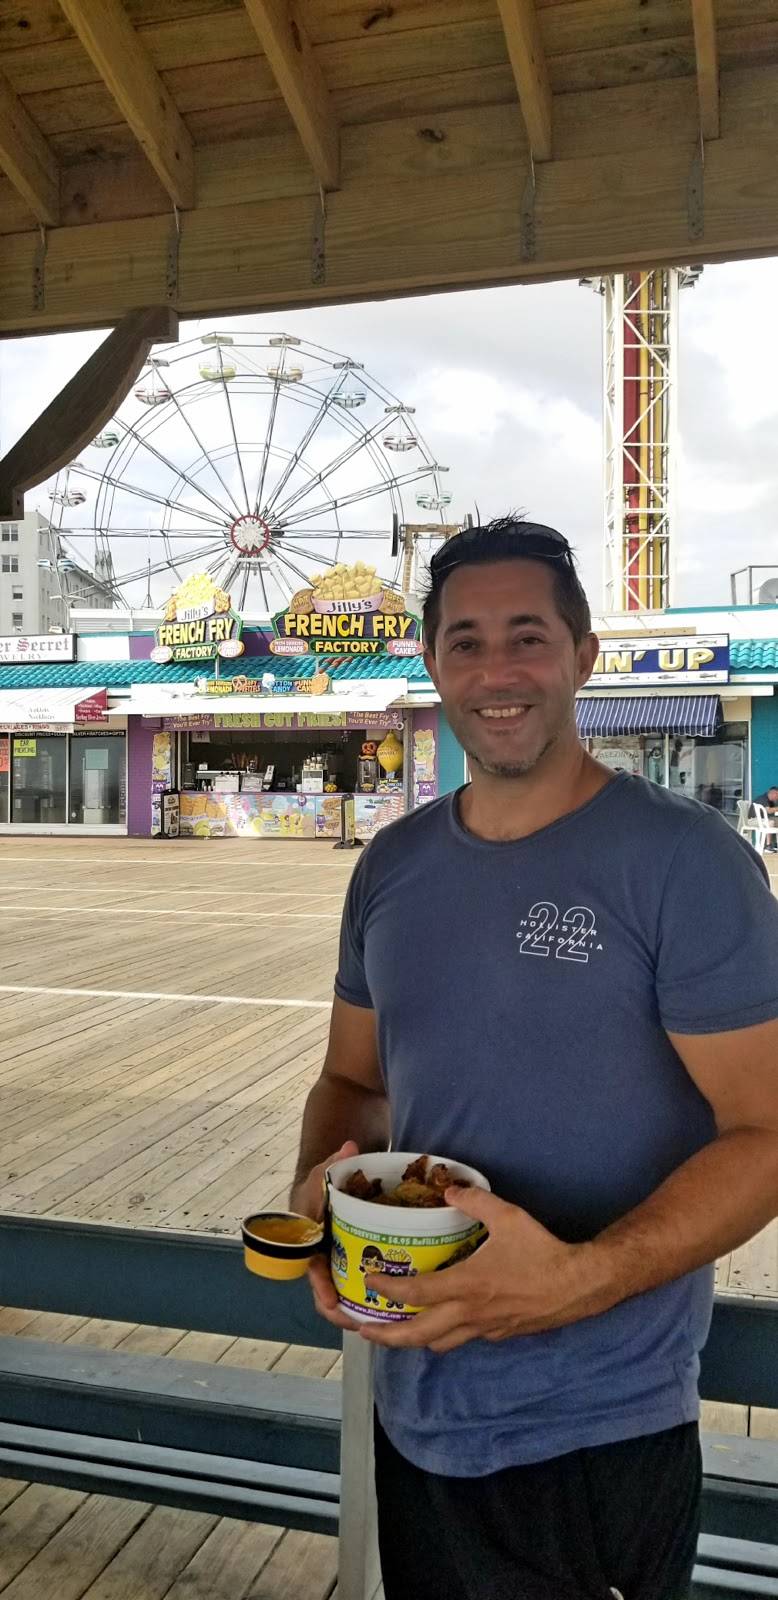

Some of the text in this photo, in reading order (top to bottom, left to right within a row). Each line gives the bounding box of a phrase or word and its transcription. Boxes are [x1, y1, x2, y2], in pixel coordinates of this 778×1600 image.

[182, 606, 208, 620] Jilly's
[327, 599, 373, 613] Jilly's
[159, 618, 233, 646] FRENCH FRY
[284, 613, 412, 638] FRENCH FRY
[17, 638, 69, 652] Secret
[176, 645, 213, 659] FACTORY
[315, 641, 378, 653] FACTORY
[394, 647, 416, 655] CAKES
[658, 648, 715, 671] UP
[214, 713, 261, 727] FRESH
[264, 712, 293, 727] CUT
[380, 712, 389, 720] Fry
[519, 901, 596, 963] 22
[520, 919, 597, 936] HOLLISTER
[516, 931, 603, 950] CALIFORNIA
